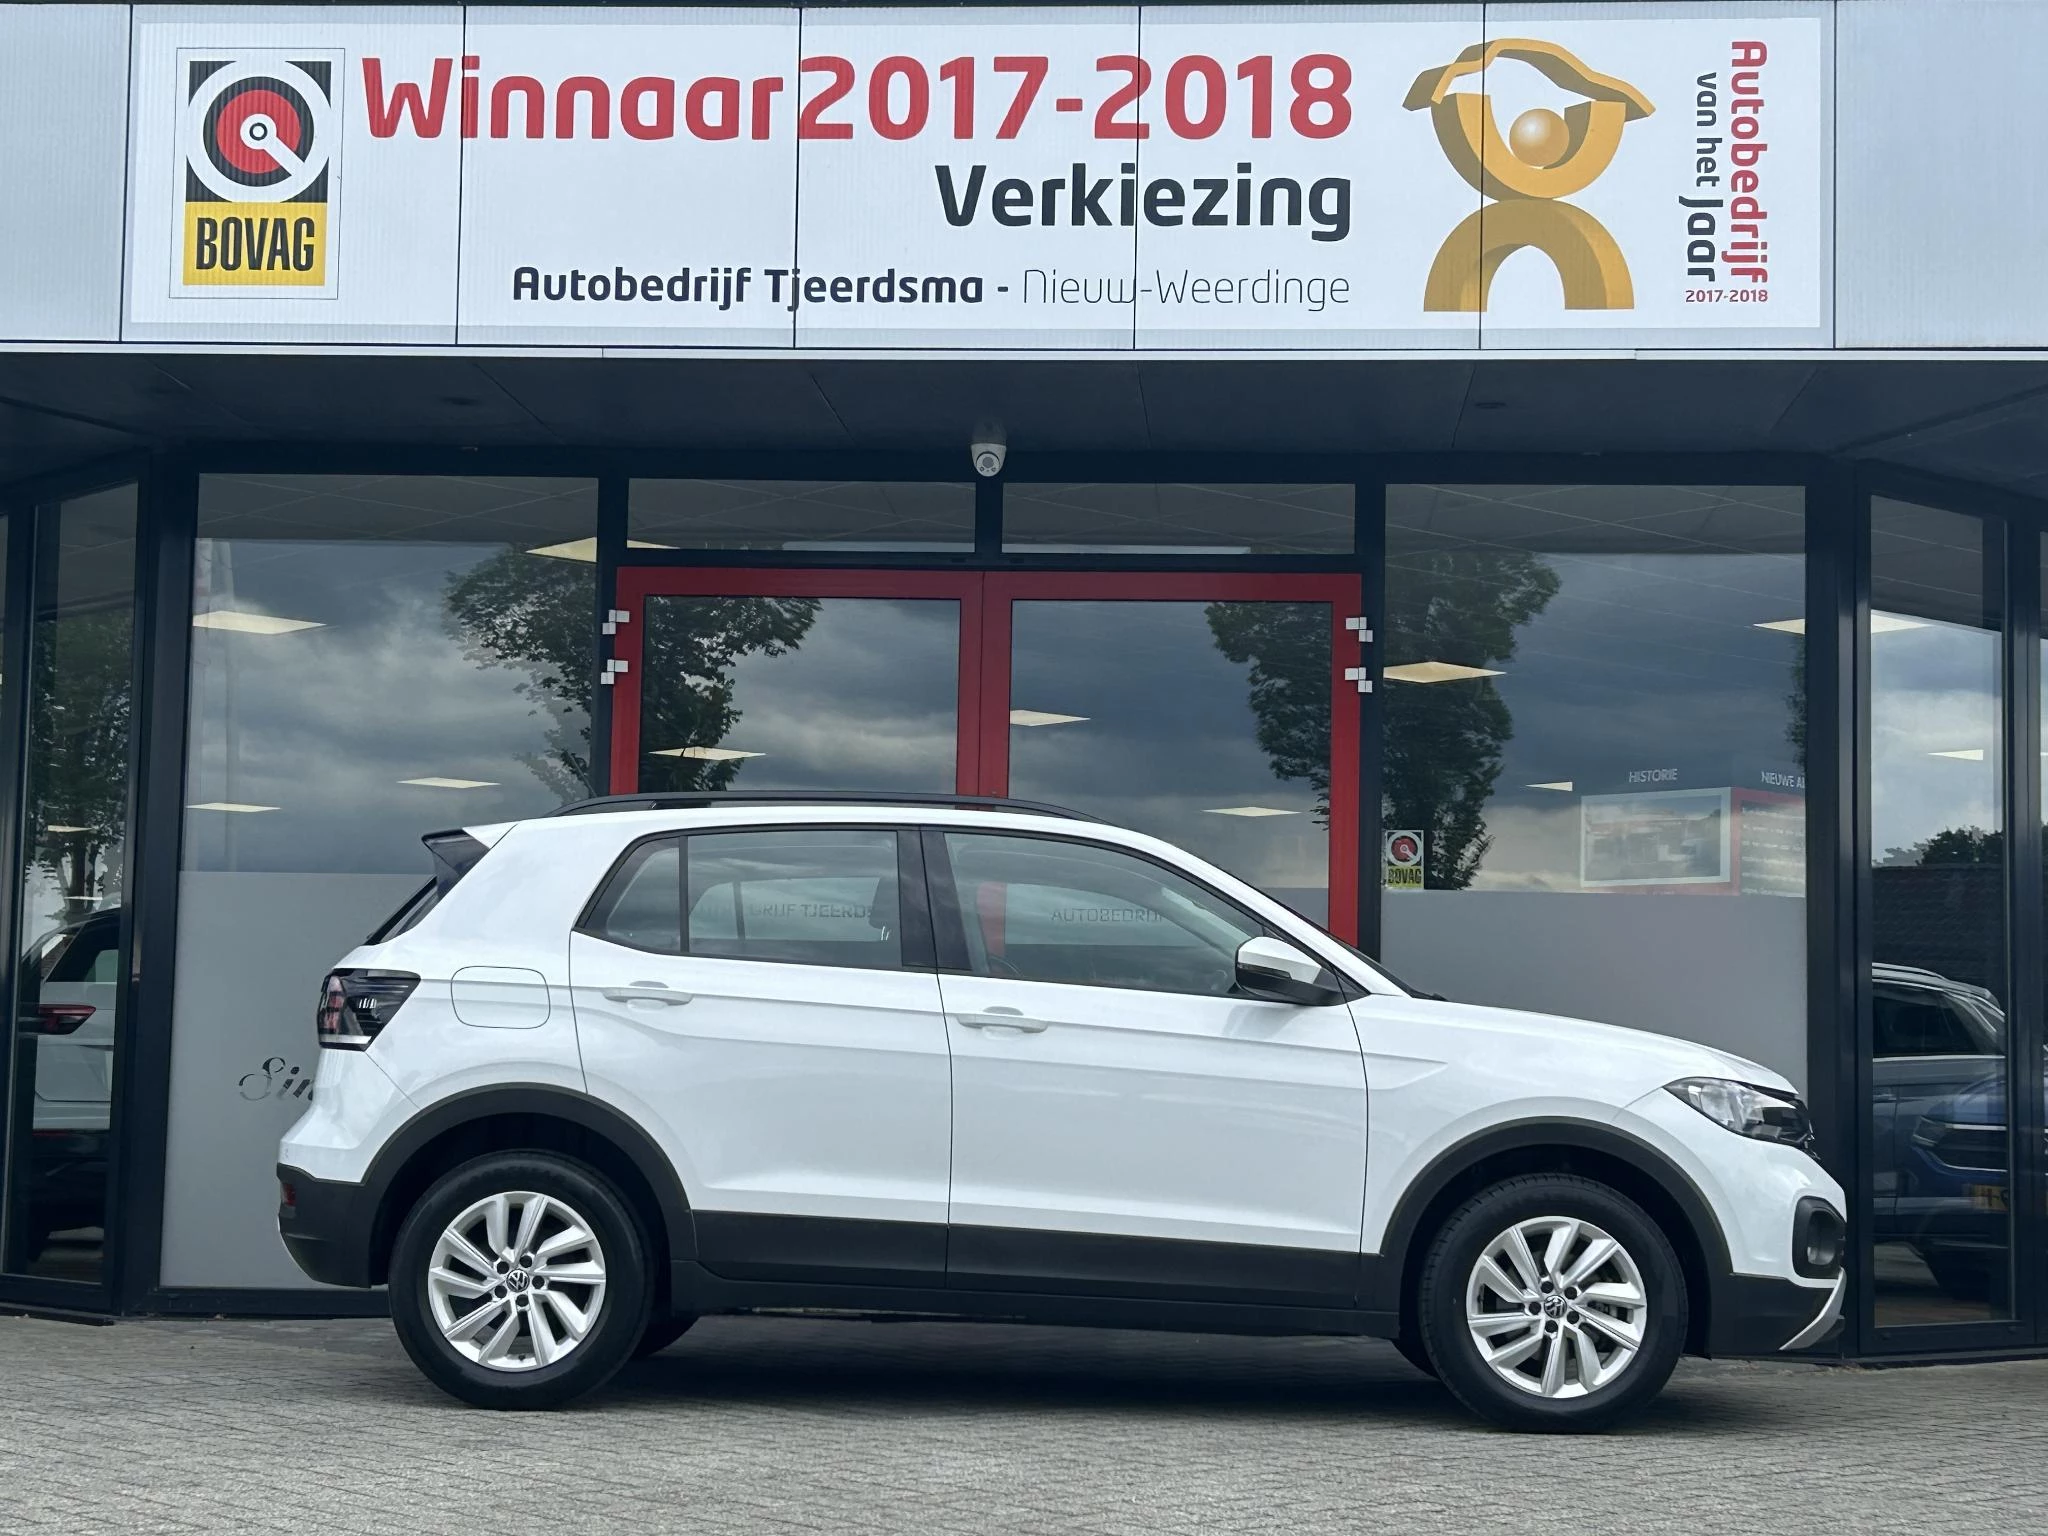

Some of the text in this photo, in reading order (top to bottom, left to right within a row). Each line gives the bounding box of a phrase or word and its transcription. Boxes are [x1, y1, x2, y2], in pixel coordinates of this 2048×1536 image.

[362, 54, 1352, 140] Winnaar 2017-2018
[1678, 72, 1724, 282] van het Jaar
[1721, 40, 1769, 283] Autobedrijf
[935, 162, 1351, 242] Verkiezing
[196, 216, 315, 272] BOVAG
[513, 266, 752, 311] Autobedrijf
[764, 267, 984, 312] Tjeerdsma
[1023, 268, 1350, 312] Nieuw-Weerdinge
[1685, 289, 1768, 303] 2017-2018
[1628, 768, 1678, 783] HISTORIE
[1761, 771, 1795, 787] NIEUWE
[1387, 868, 1422, 884] BOVAG
